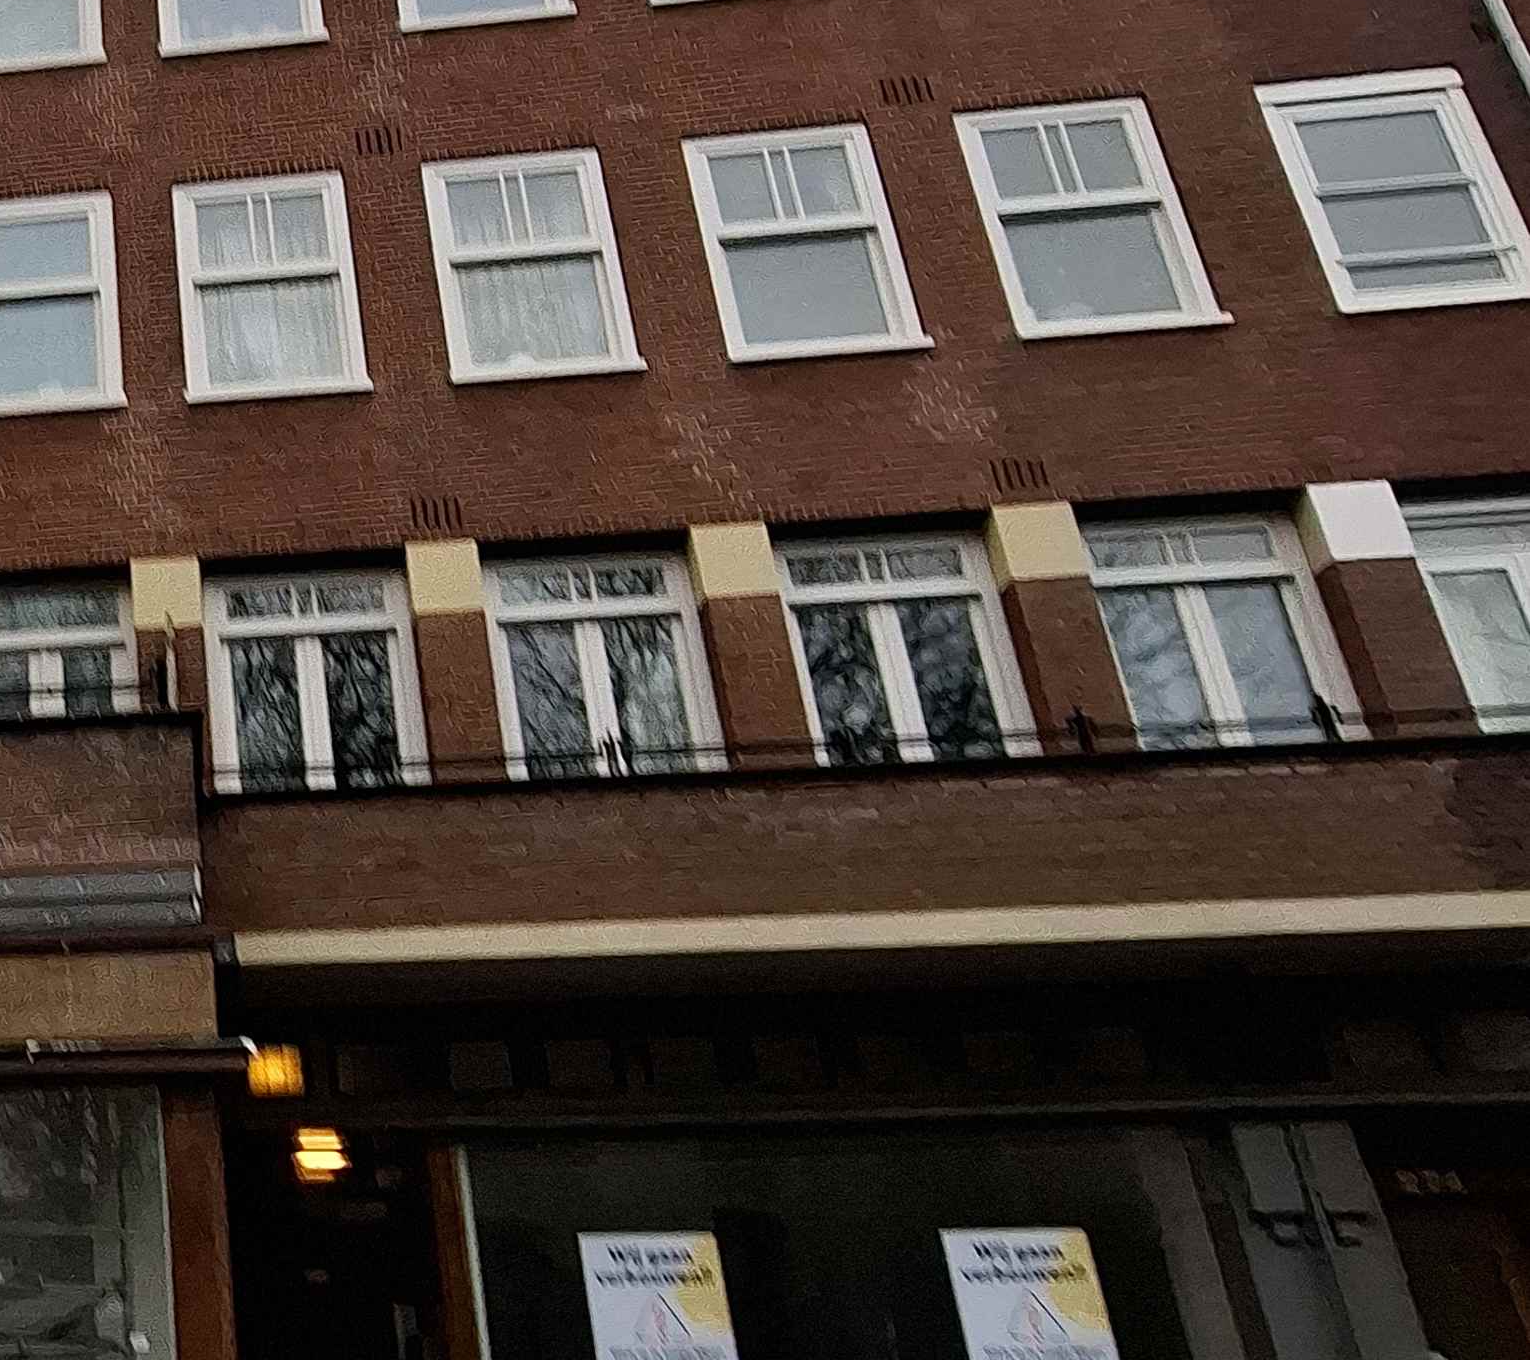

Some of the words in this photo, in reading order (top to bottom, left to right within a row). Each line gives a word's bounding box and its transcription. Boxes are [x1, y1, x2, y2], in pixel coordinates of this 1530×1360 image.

[607, 1243, 643, 1266] Wij
[644, 1247, 694, 1268] gaan
[972, 1241, 1011, 1264] Wij
[1012, 1244, 1067, 1264] gaan
